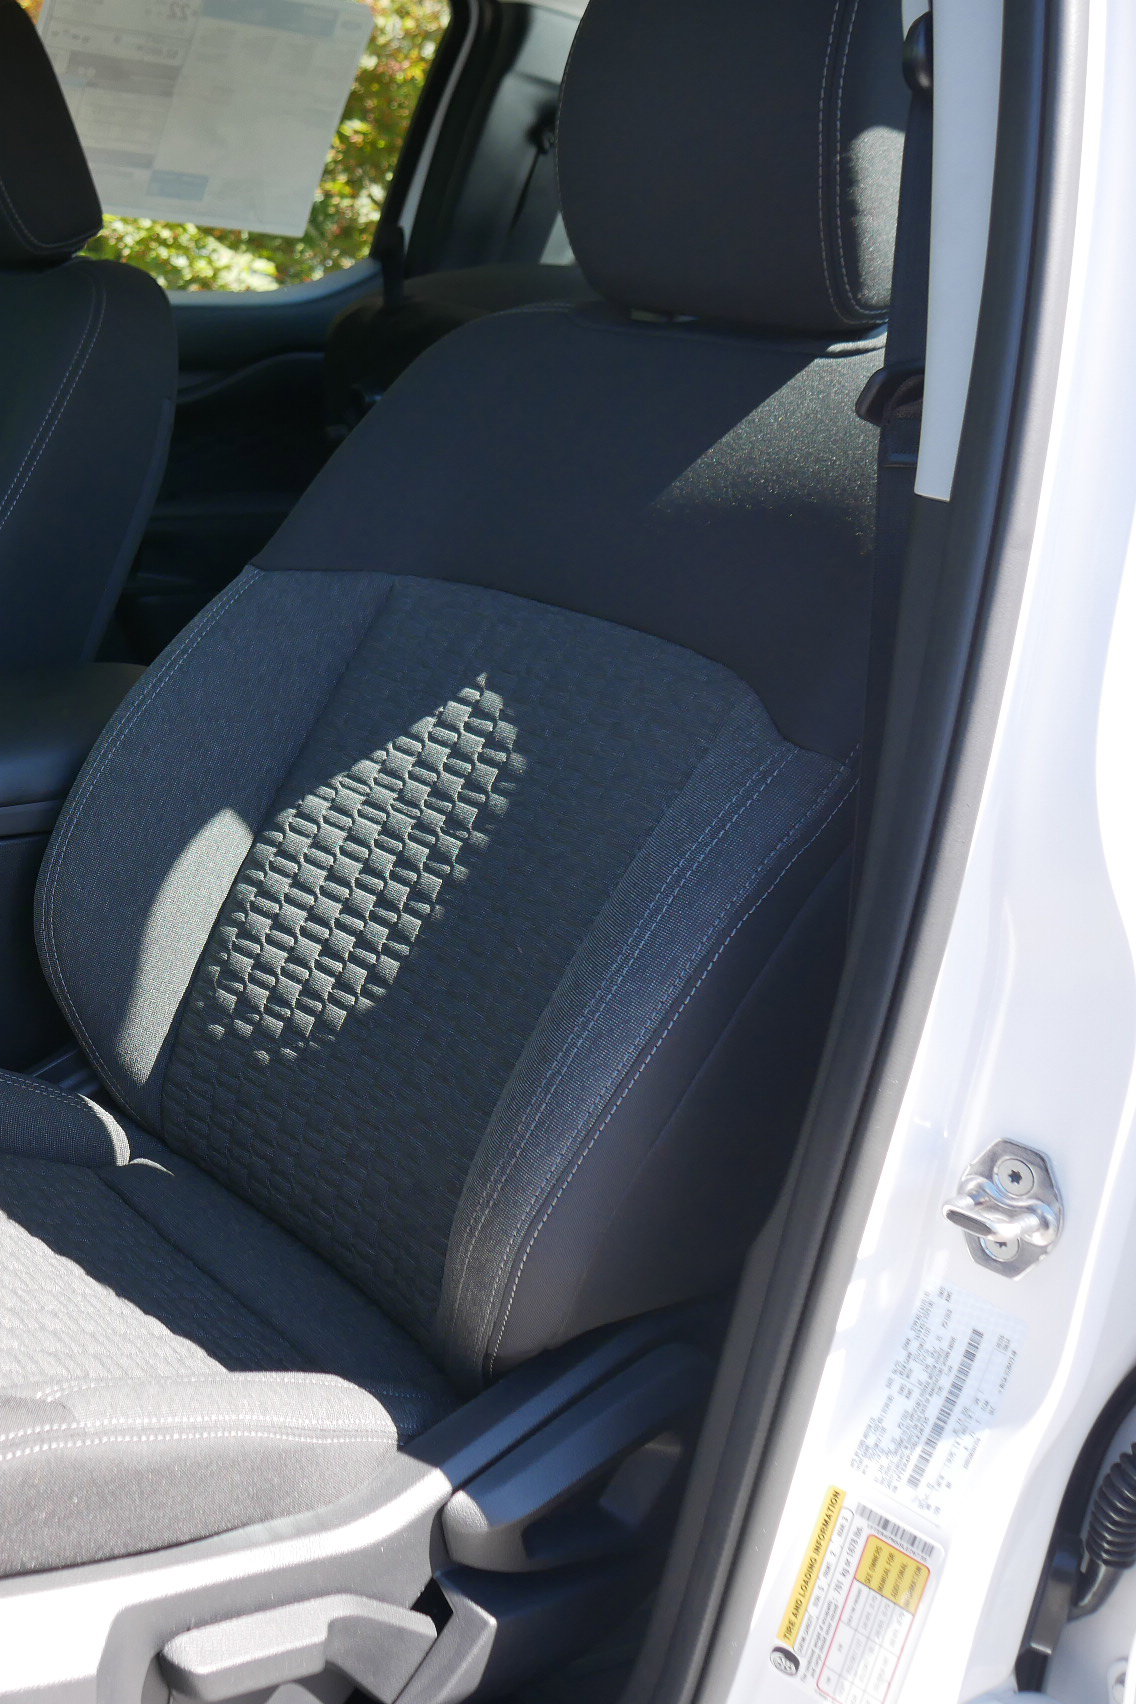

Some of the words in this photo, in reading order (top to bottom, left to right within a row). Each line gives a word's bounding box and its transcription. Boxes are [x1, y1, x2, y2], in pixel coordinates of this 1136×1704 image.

[783, 1617, 796, 1640] TIRE
[793, 1599, 803, 1618] AND
[799, 1556, 817, 1597] LOADING
[813, 1490, 840, 1555] INFORMATION
